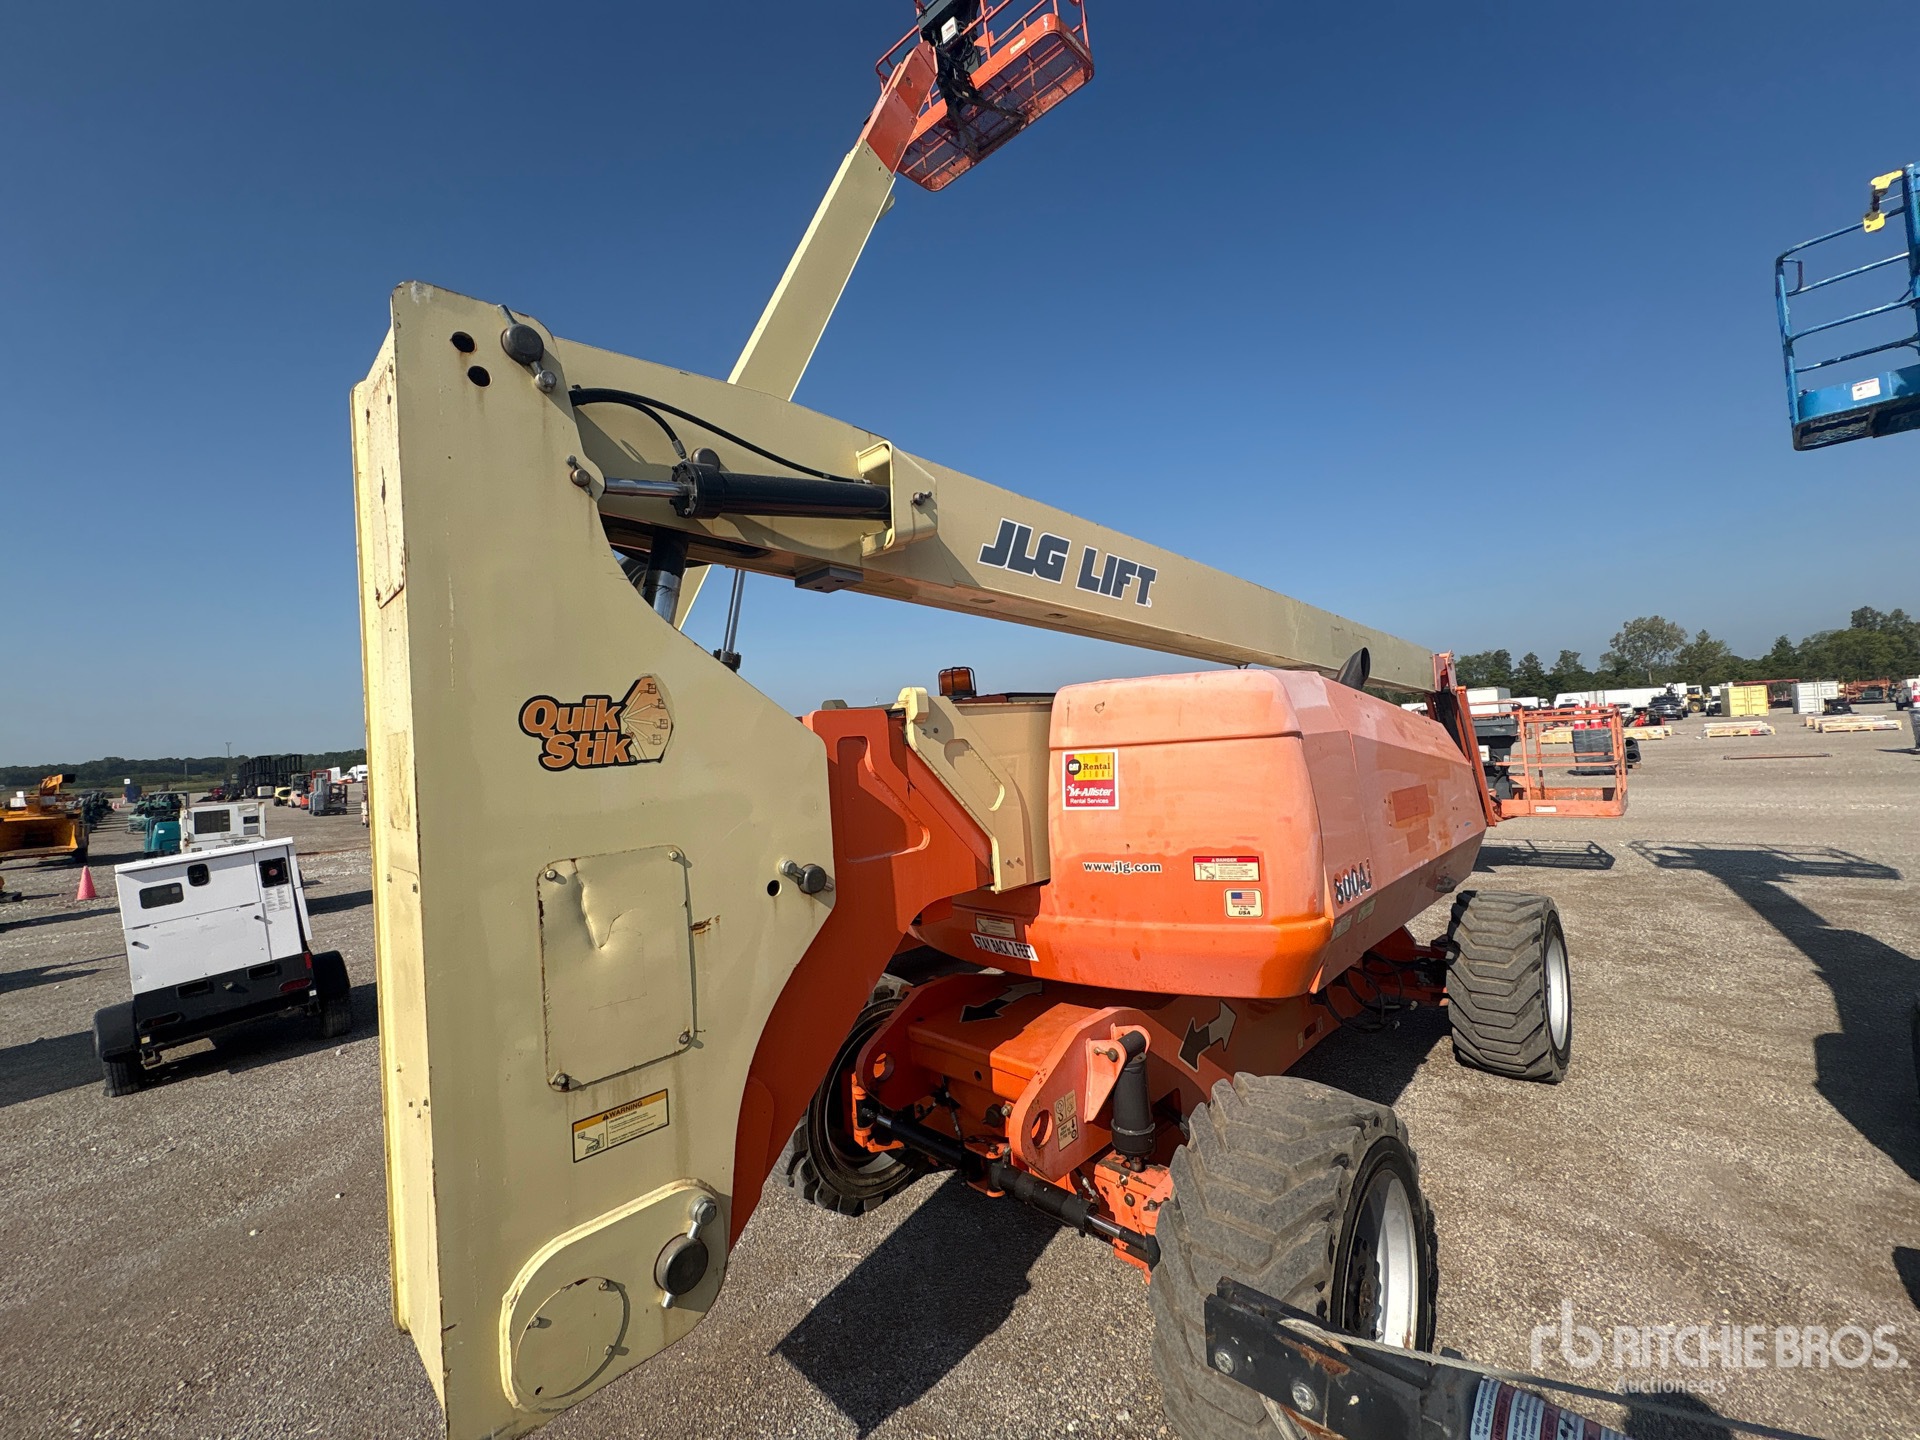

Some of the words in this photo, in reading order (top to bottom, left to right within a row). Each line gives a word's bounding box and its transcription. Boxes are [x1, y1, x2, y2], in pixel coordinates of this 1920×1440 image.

[977, 518, 1071, 584] JLG
[1075, 545, 1158, 606] LIFT
[521, 698, 622, 738] Quik
[542, 731, 632, 768] Stik
[1068, 763, 1080, 771] CAT
[1083, 861, 1162, 874] www.jlg.com
[974, 935, 992, 952] STAY
[990, 939, 1012, 955] BACK
[1009, 942, 1017, 957] 2
[1015, 943, 1034, 960] FEET
[608, 1101, 643, 1118] WARNING
